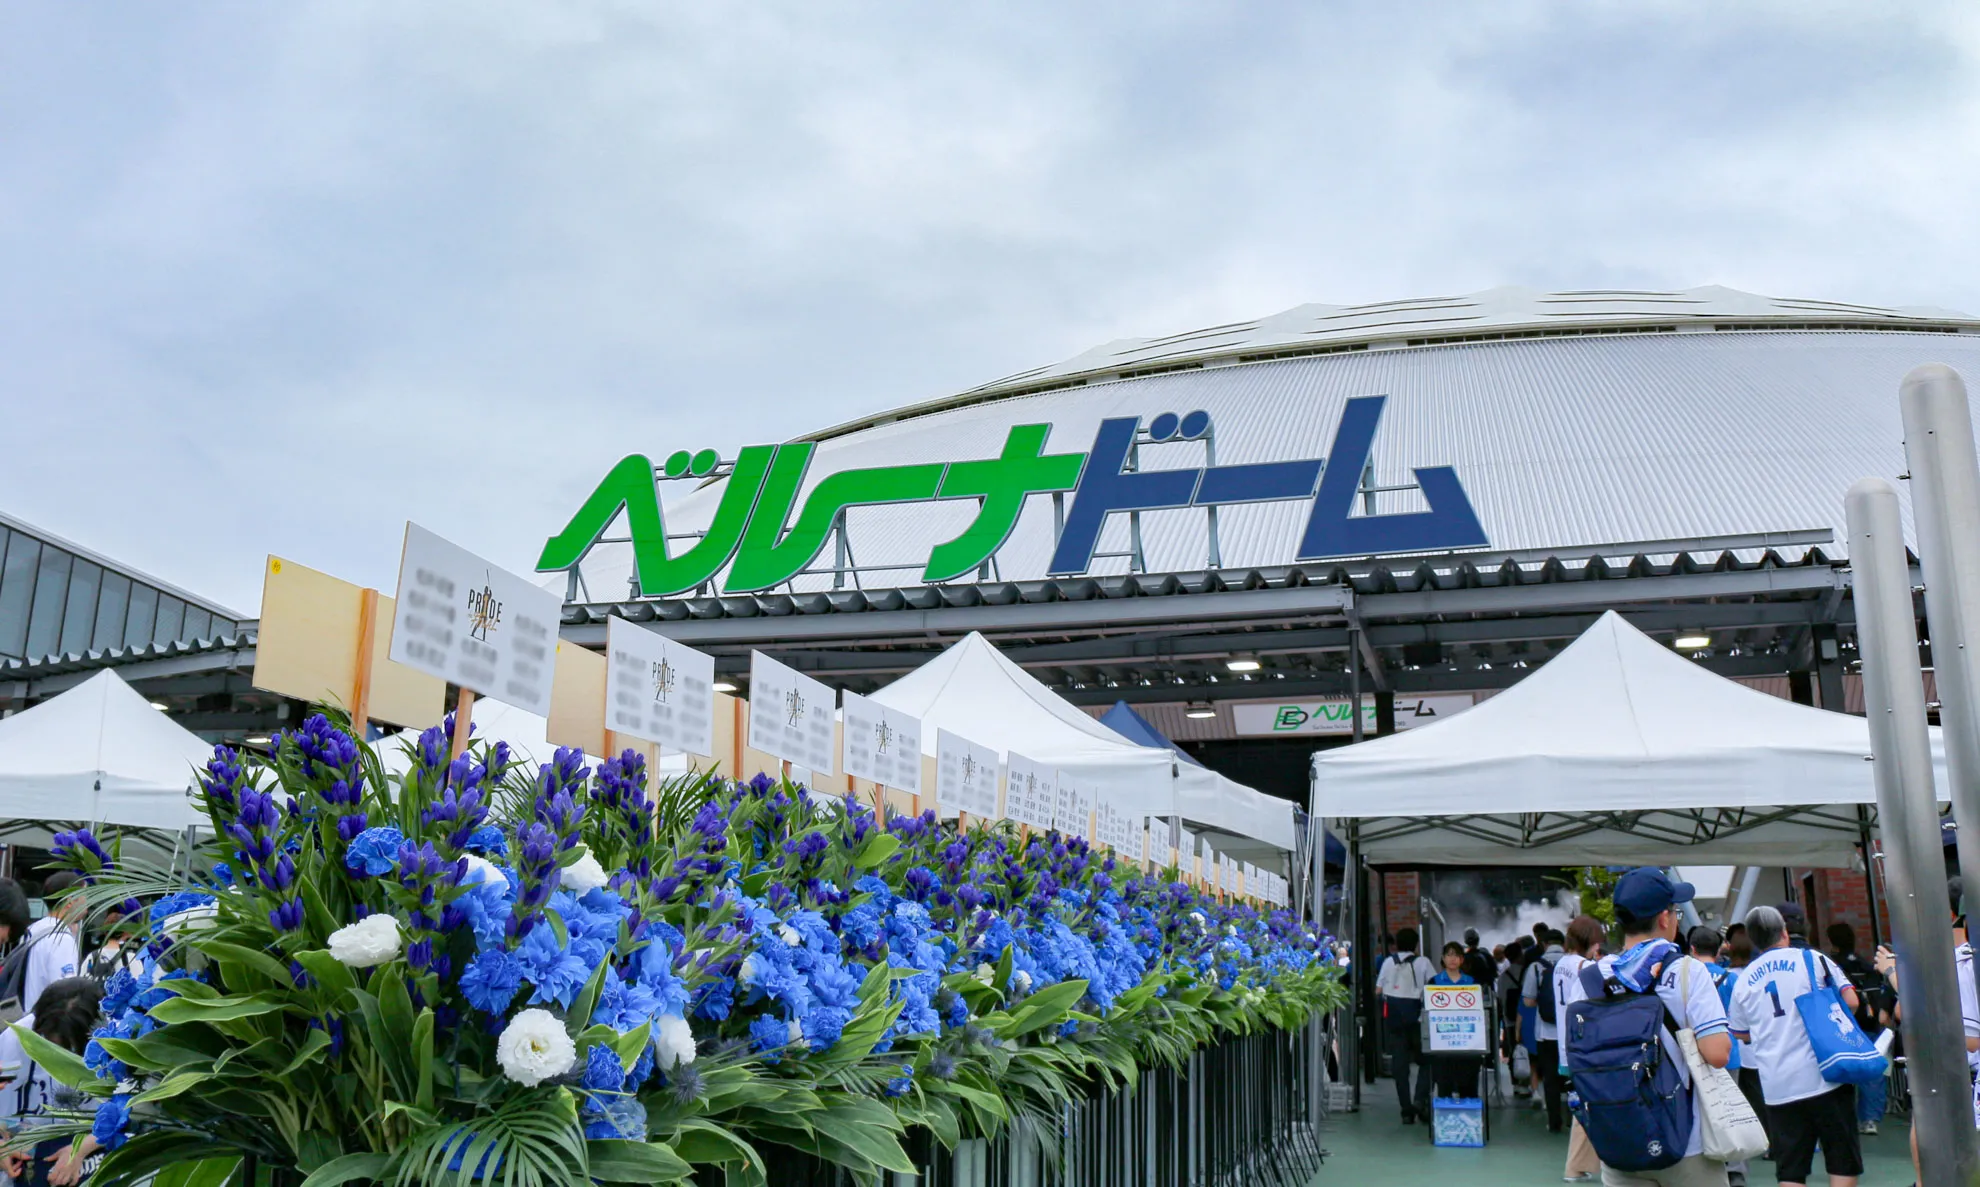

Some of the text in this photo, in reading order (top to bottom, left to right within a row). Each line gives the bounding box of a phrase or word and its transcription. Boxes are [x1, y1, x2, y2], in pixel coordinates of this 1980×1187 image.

[535, 394, 1491, 598] ベルーナドーム
[1746, 959, 1796, 987] KURIYAMA
[1558, 979, 1566, 1006] 1
[1764, 980, 1786, 1018] 1
